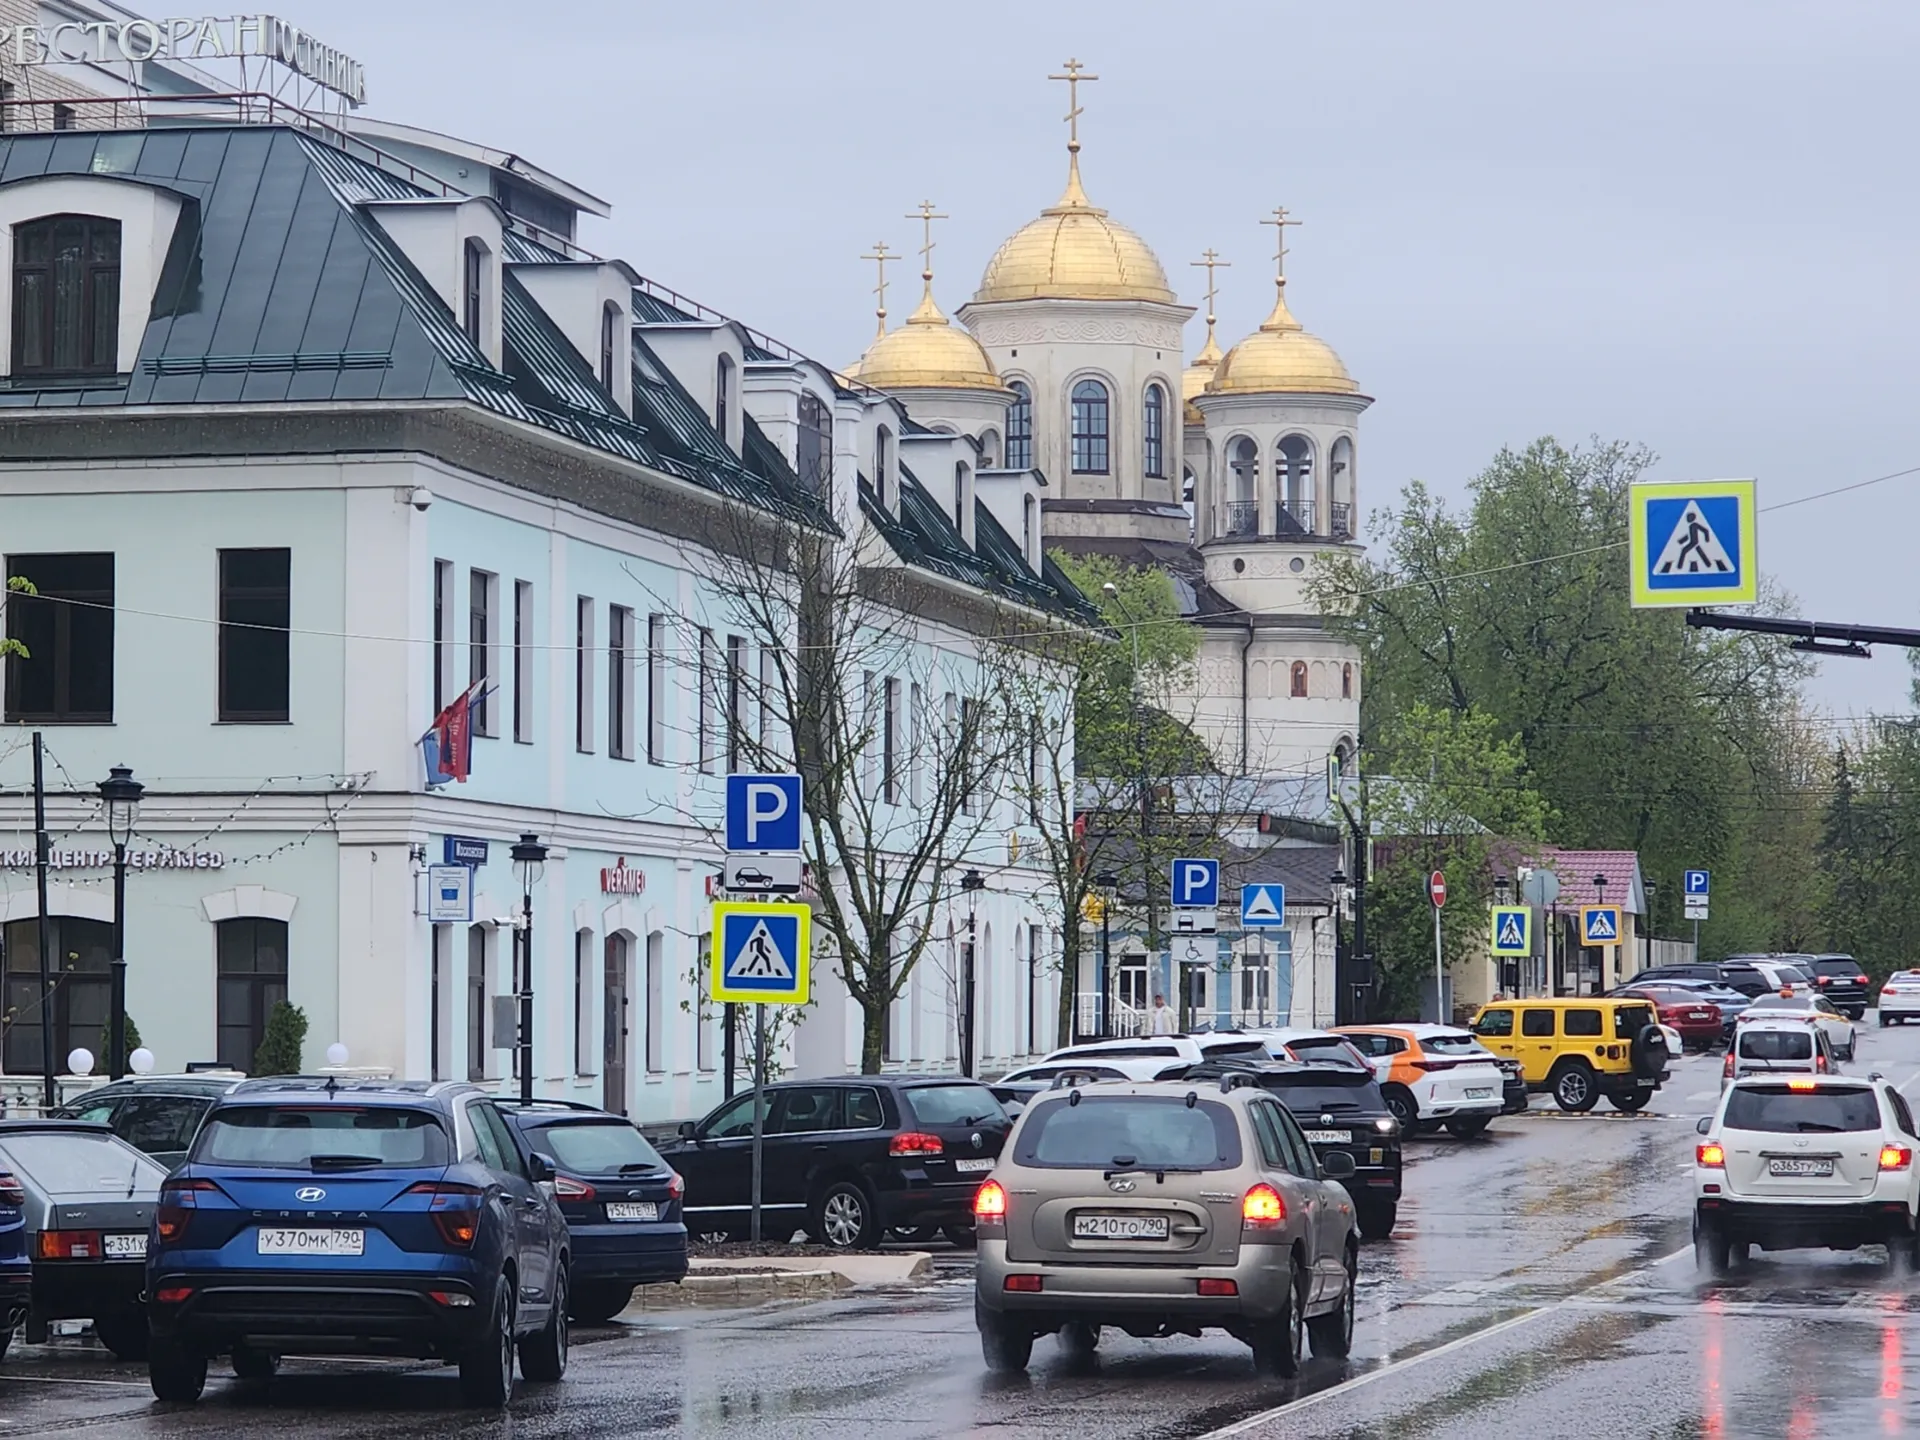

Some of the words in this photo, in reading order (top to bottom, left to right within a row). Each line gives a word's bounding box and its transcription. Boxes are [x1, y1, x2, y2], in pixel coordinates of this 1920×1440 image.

[747, 784, 788, 842] P
[0, 850, 38, 867] КИ
[48, 848, 110, 869] ЦЕНТР
[1185, 864, 1210, 901] P
[1691, 873, 1705, 892] P
[252, 1210, 369, 1219] CRETA
[1078, 1219, 1138, 1233] М210ТО
[1140, 1219, 1163, 1230] 790
[264, 1231, 330, 1248] У370МК
[333, 1231, 360, 1244] 790
